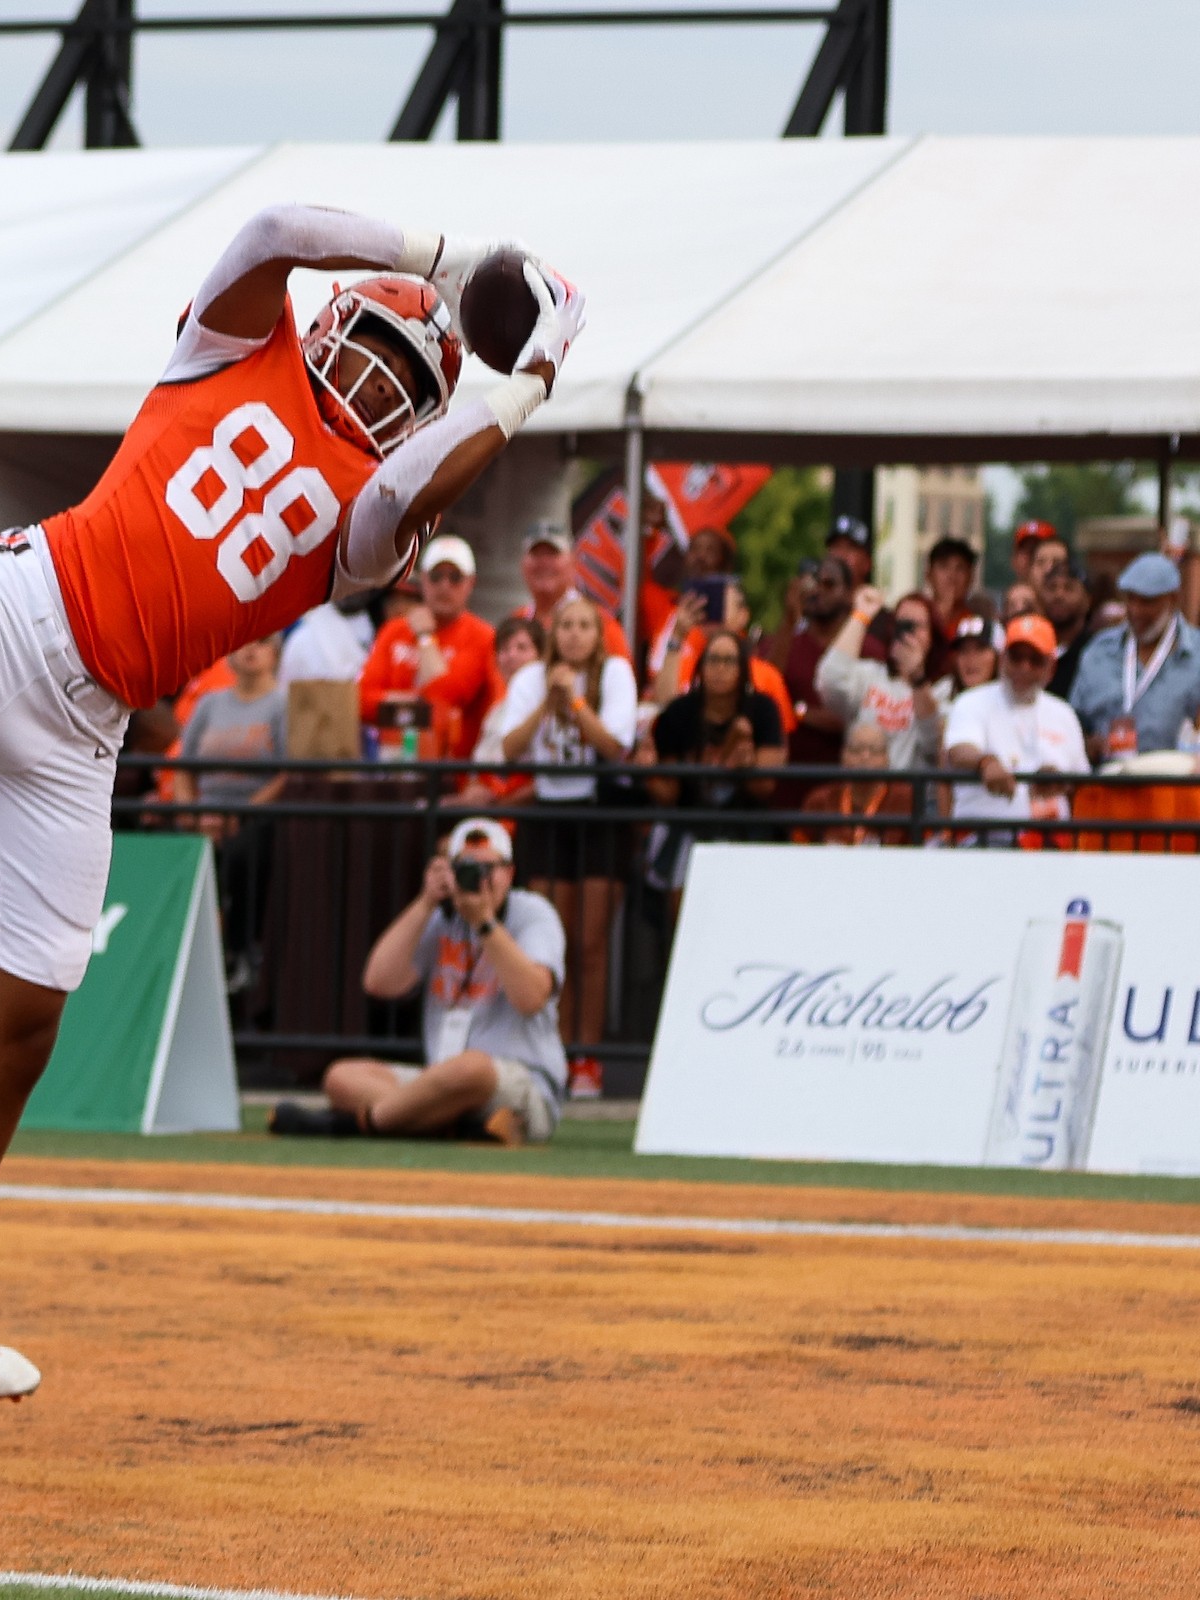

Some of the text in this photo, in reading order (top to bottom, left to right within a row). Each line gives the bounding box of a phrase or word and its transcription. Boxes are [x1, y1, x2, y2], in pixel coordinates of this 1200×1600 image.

[164, 401, 341, 603] 88
[700, 962, 1003, 1033] Michelob
[1021, 998, 1080, 1165] ULTRA
